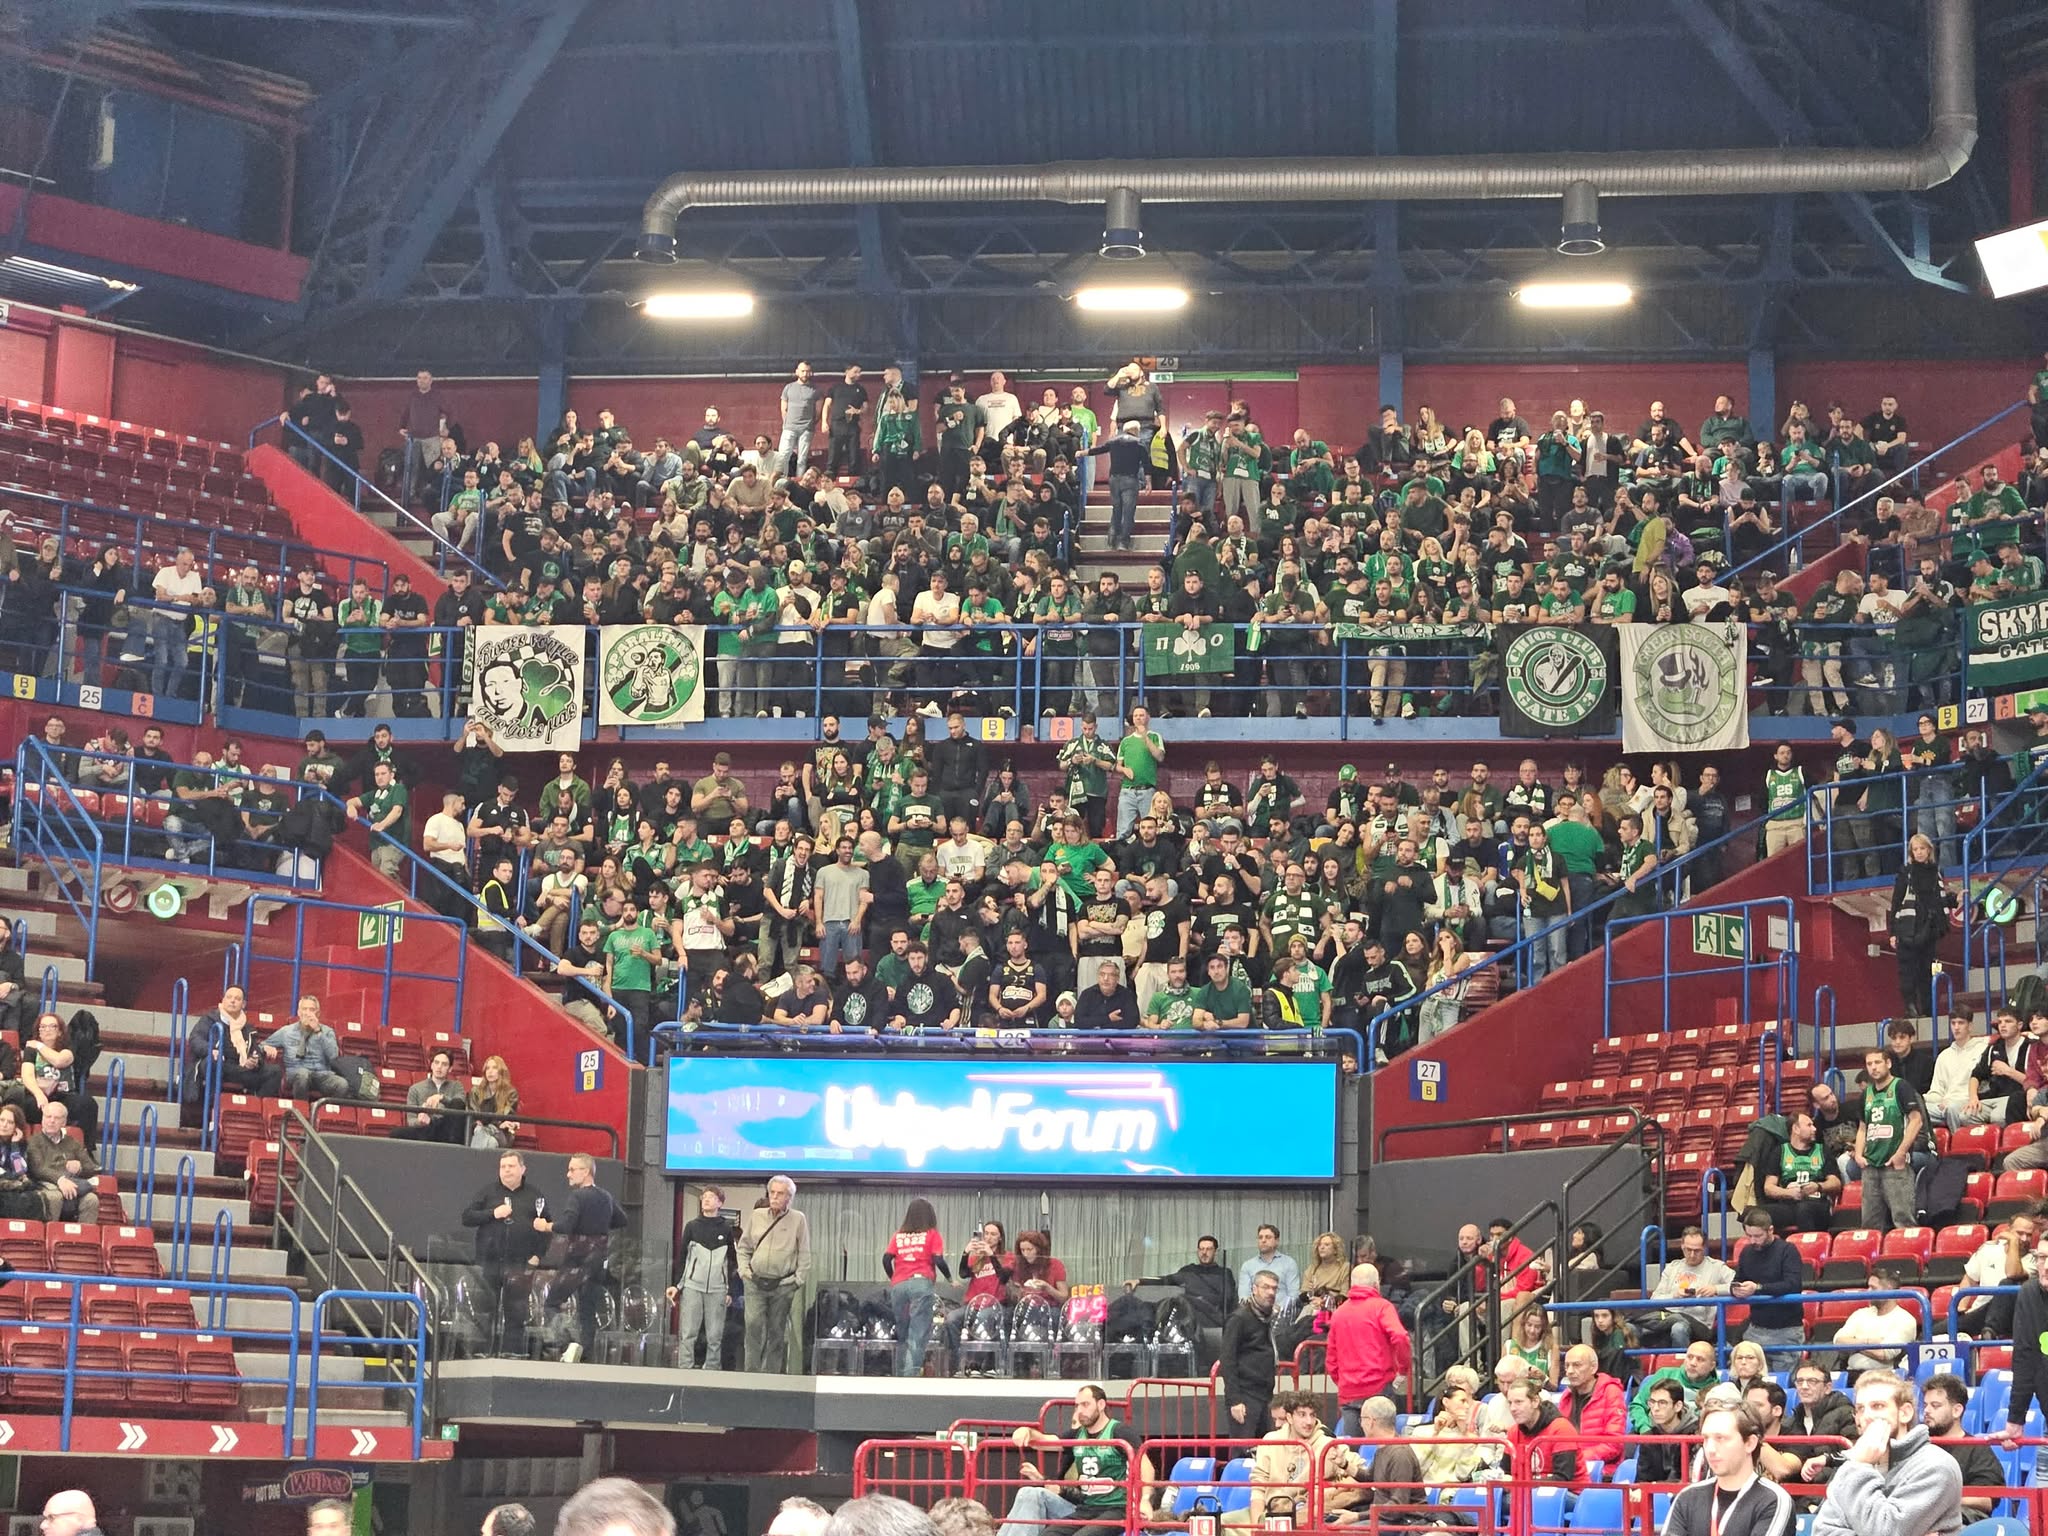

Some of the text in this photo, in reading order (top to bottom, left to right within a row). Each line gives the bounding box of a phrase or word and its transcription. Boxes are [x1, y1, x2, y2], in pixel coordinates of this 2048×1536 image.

[1509, 630, 1601, 665] CHIOS CLUB
[20, 678, 29, 688] B
[81, 690, 100, 704] 25
[138, 704, 146, 714] C
[1517, 691, 1570, 722] GATE
[1943, 708, 1952, 718] B
[1968, 703, 1986, 718] 27
[2000, 706, 2008, 718] C
[988, 720, 998, 730] B
[1057, 728, 1065, 738] C
[584, 1054, 596, 1068] 25
[1421, 1063, 1437, 1078] 27
[1426, 1086, 1432, 1096] B
[1871, 1105, 1884, 1122] 25
[1082, 1456, 1099, 1475] 25
